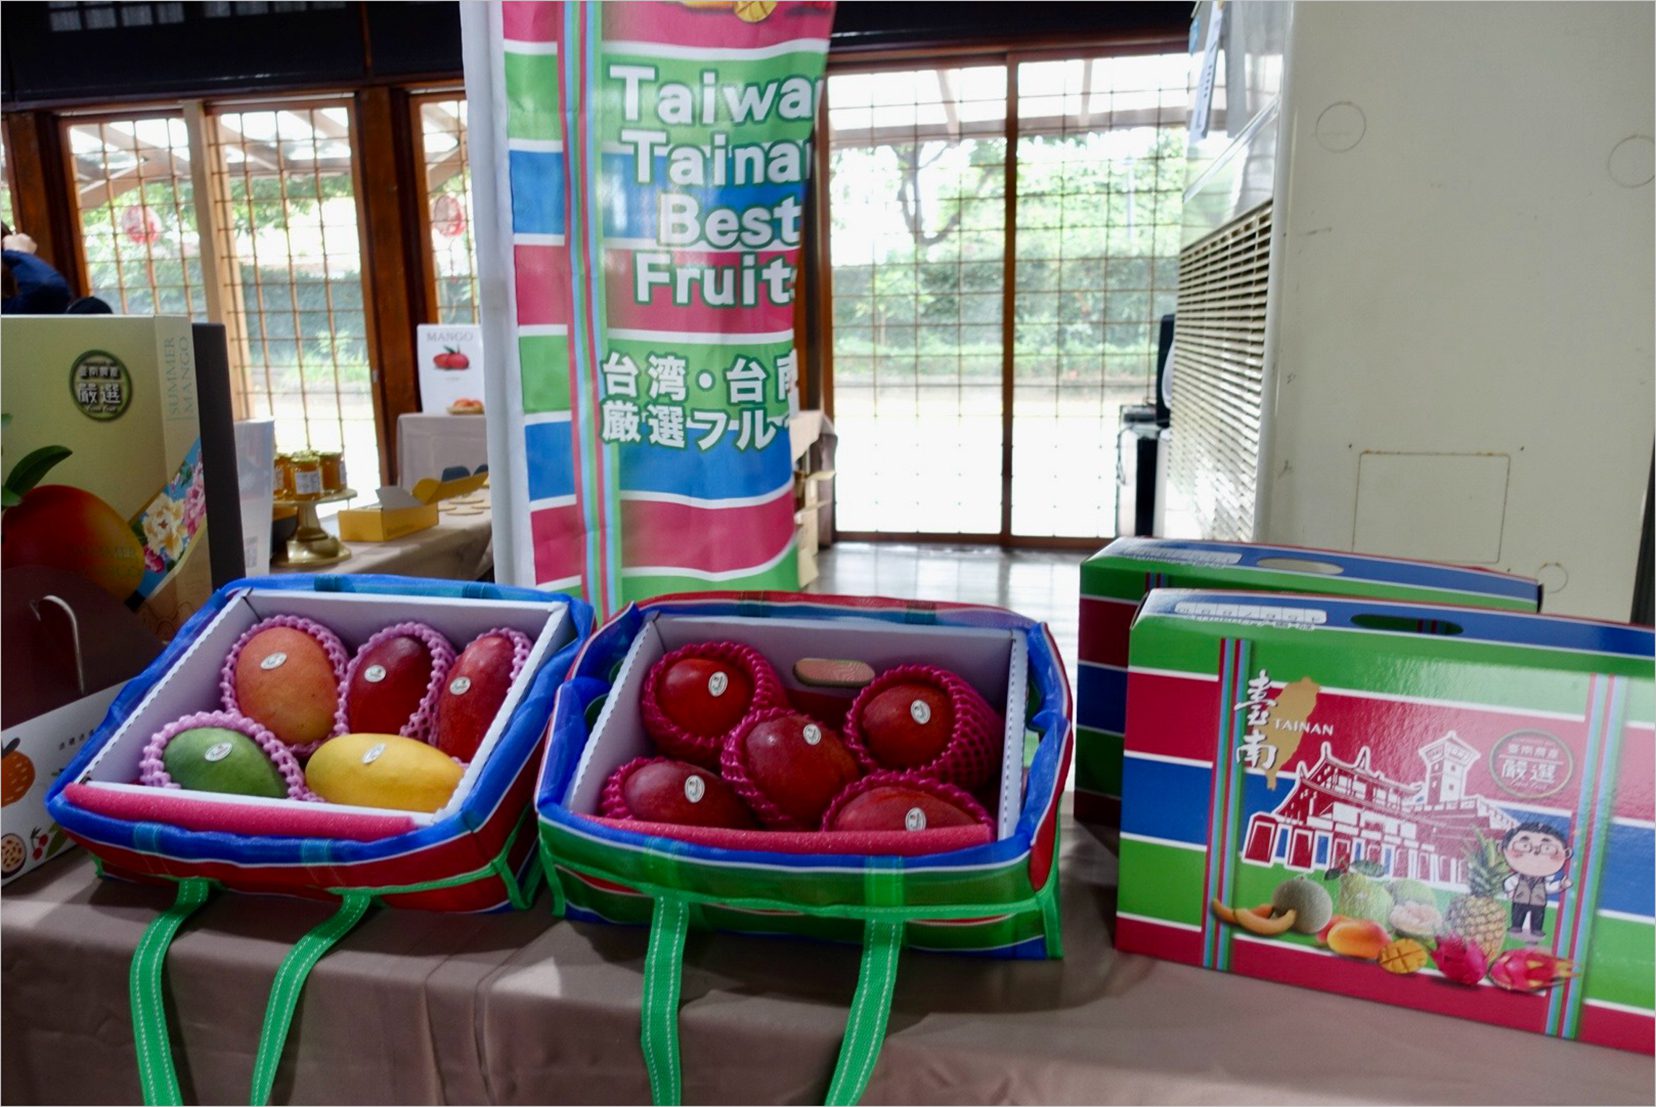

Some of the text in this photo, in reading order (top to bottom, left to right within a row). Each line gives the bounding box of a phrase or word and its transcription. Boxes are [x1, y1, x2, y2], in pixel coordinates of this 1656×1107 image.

[609, 64, 824, 125] Taiwa
[620, 129, 813, 186] Taina
[660, 192, 801, 246] Best
[602, 400, 790, 451] 厳選フル
[1274, 718, 1334, 737] TAINAN
